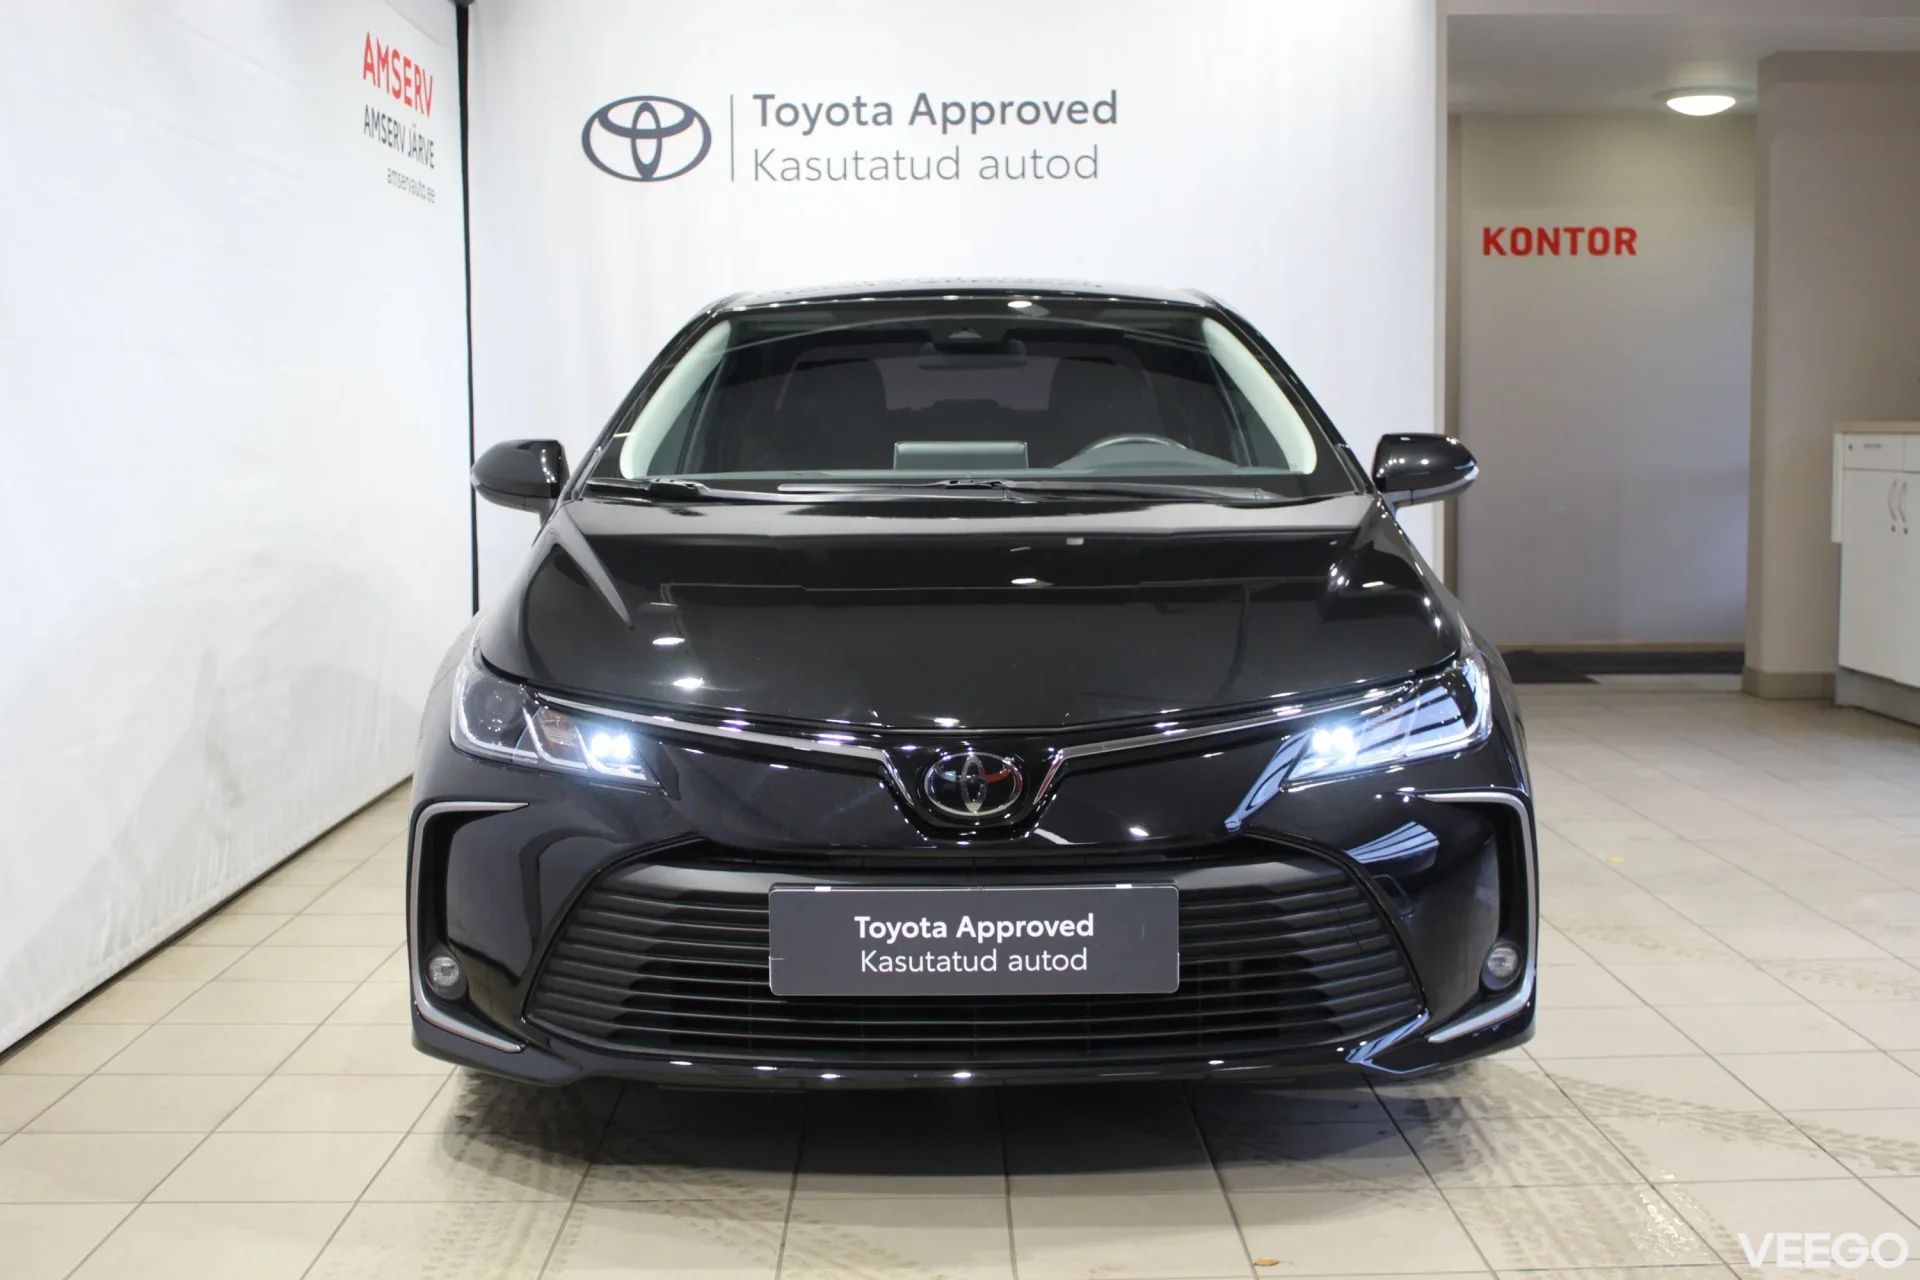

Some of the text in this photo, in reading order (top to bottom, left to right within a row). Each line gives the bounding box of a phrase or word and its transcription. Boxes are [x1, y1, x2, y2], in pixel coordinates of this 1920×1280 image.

[363, 31, 434, 118] AMSERV
[752, 89, 1118, 136] Toyota Approved
[364, 104, 434, 169] AMSERV JÄRVE
[753, 144, 1099, 182] Kasutatud autod
[1482, 226, 1638, 256] KONTOR
[854, 912, 1094, 944] Toyota Approved
[861, 947, 1088, 973] Kasutatud autod
